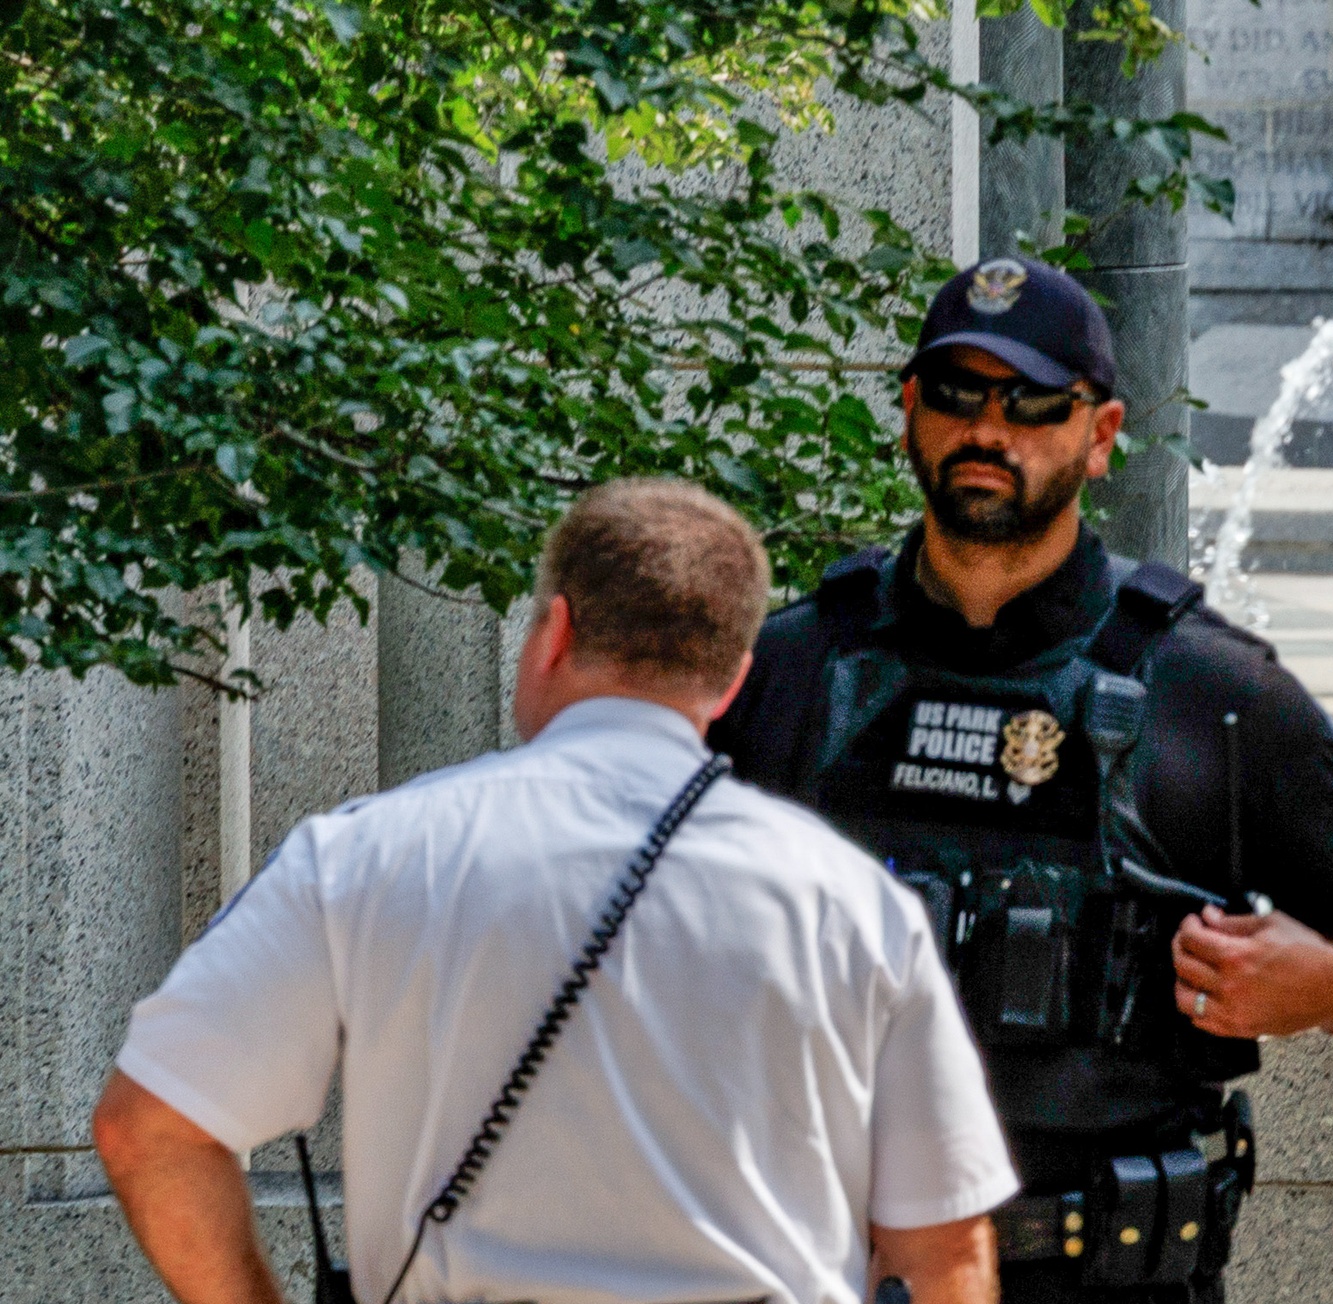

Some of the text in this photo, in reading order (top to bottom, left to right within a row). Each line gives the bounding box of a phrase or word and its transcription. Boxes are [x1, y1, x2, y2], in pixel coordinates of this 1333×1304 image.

[914, 701, 1002, 733] US PARK
[907, 726, 998, 766] POLICE
